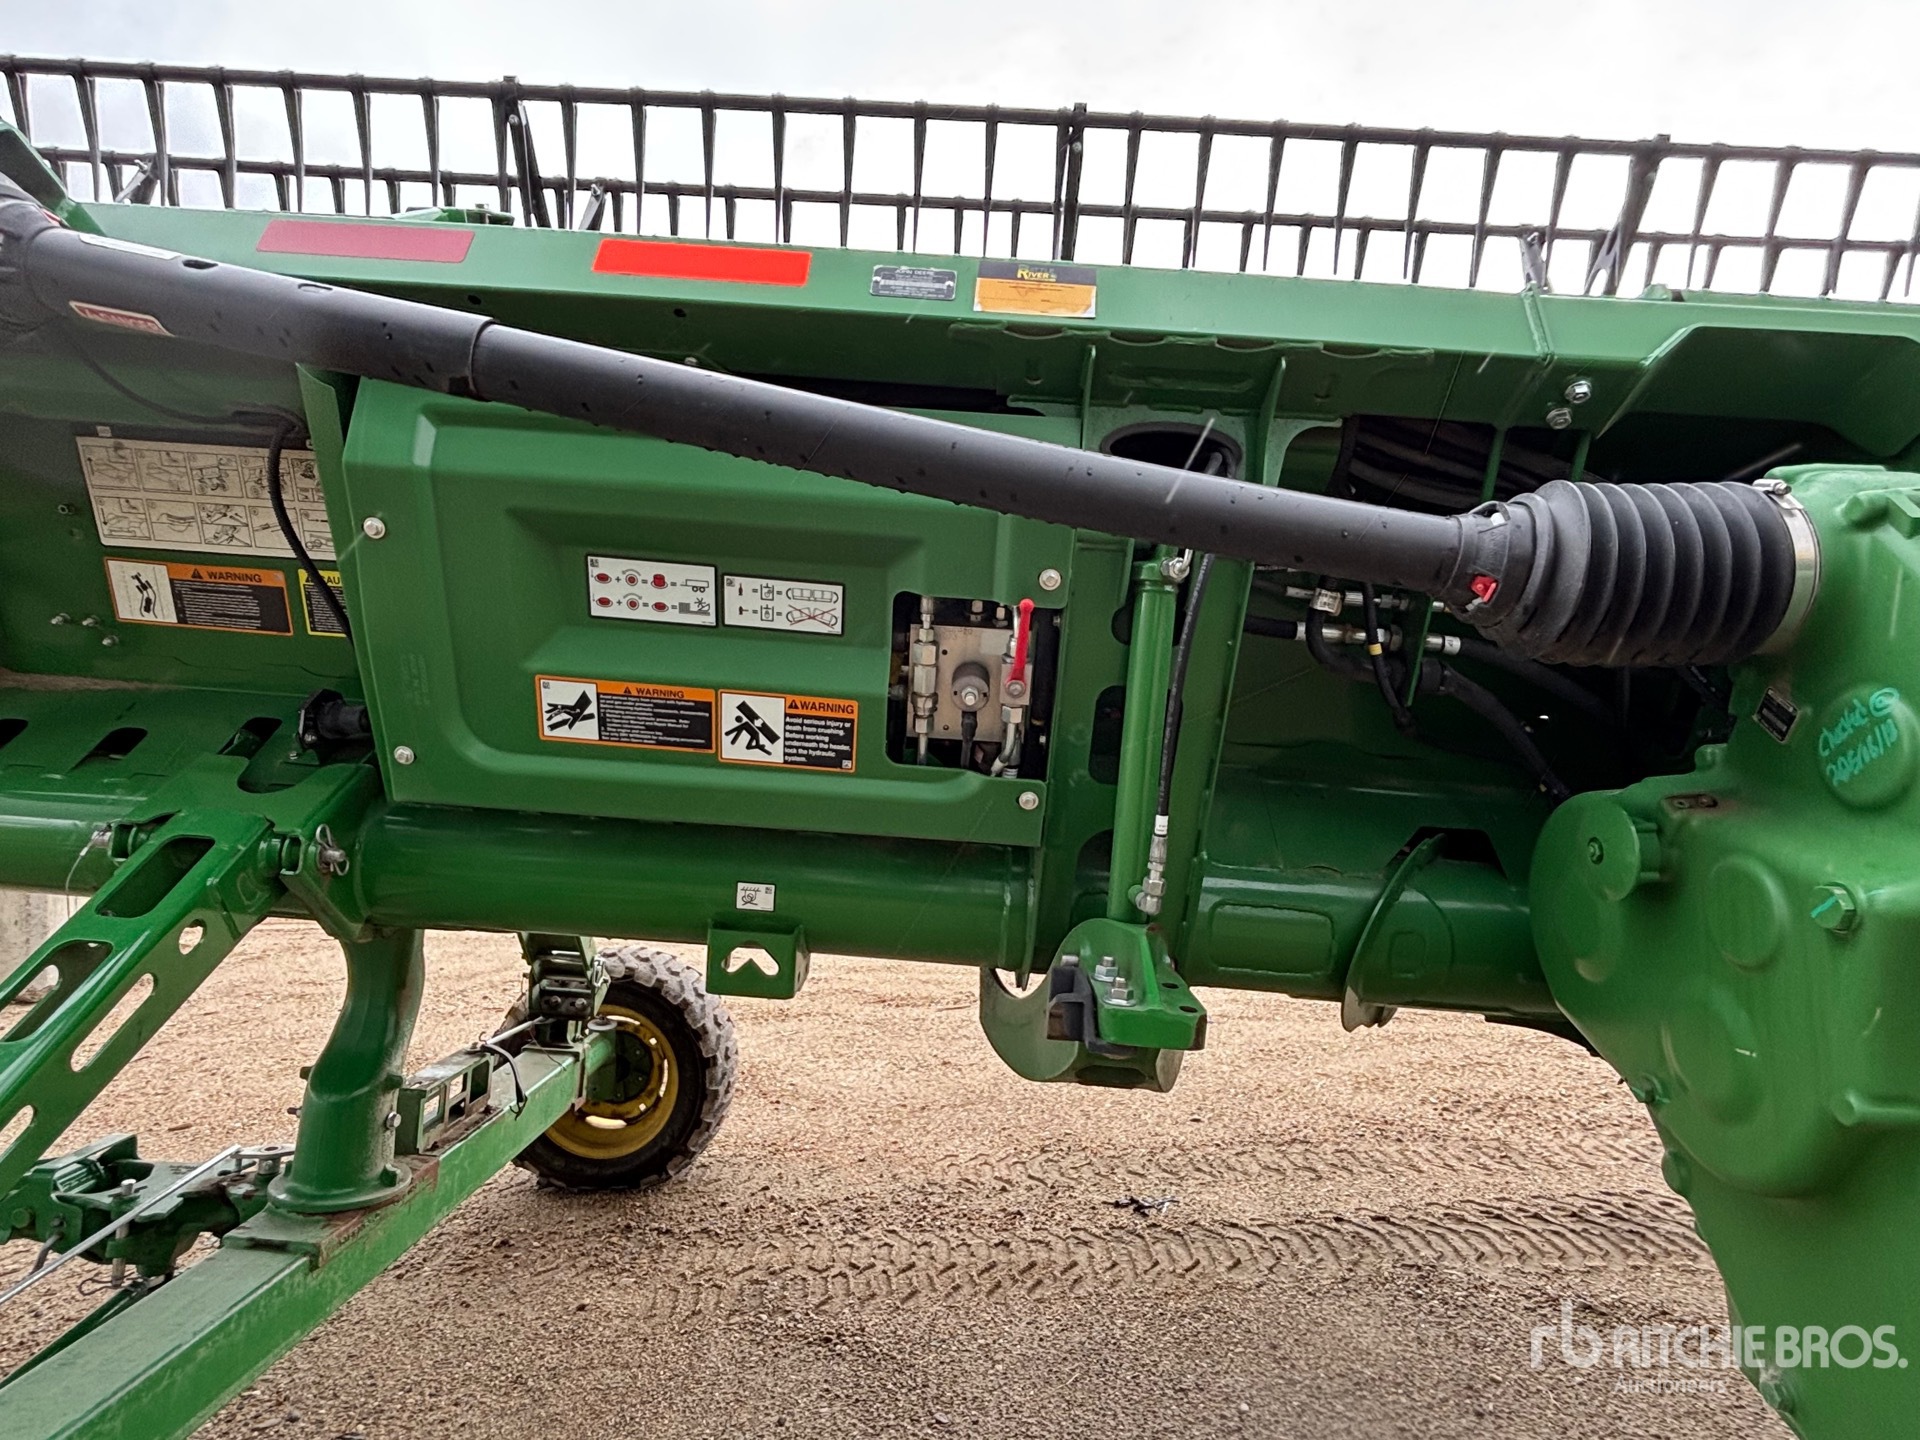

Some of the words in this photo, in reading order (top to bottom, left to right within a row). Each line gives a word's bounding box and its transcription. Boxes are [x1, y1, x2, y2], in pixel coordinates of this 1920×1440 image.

[206, 570, 263, 583] WARNING
[636, 687, 685, 699] WARNING
[799, 700, 854, 714] WARNING
[785, 716, 803, 724] Avoid
[826, 720, 844, 728] injury
[805, 734, 829, 743] working
[808, 749, 836, 757] hydraulic
